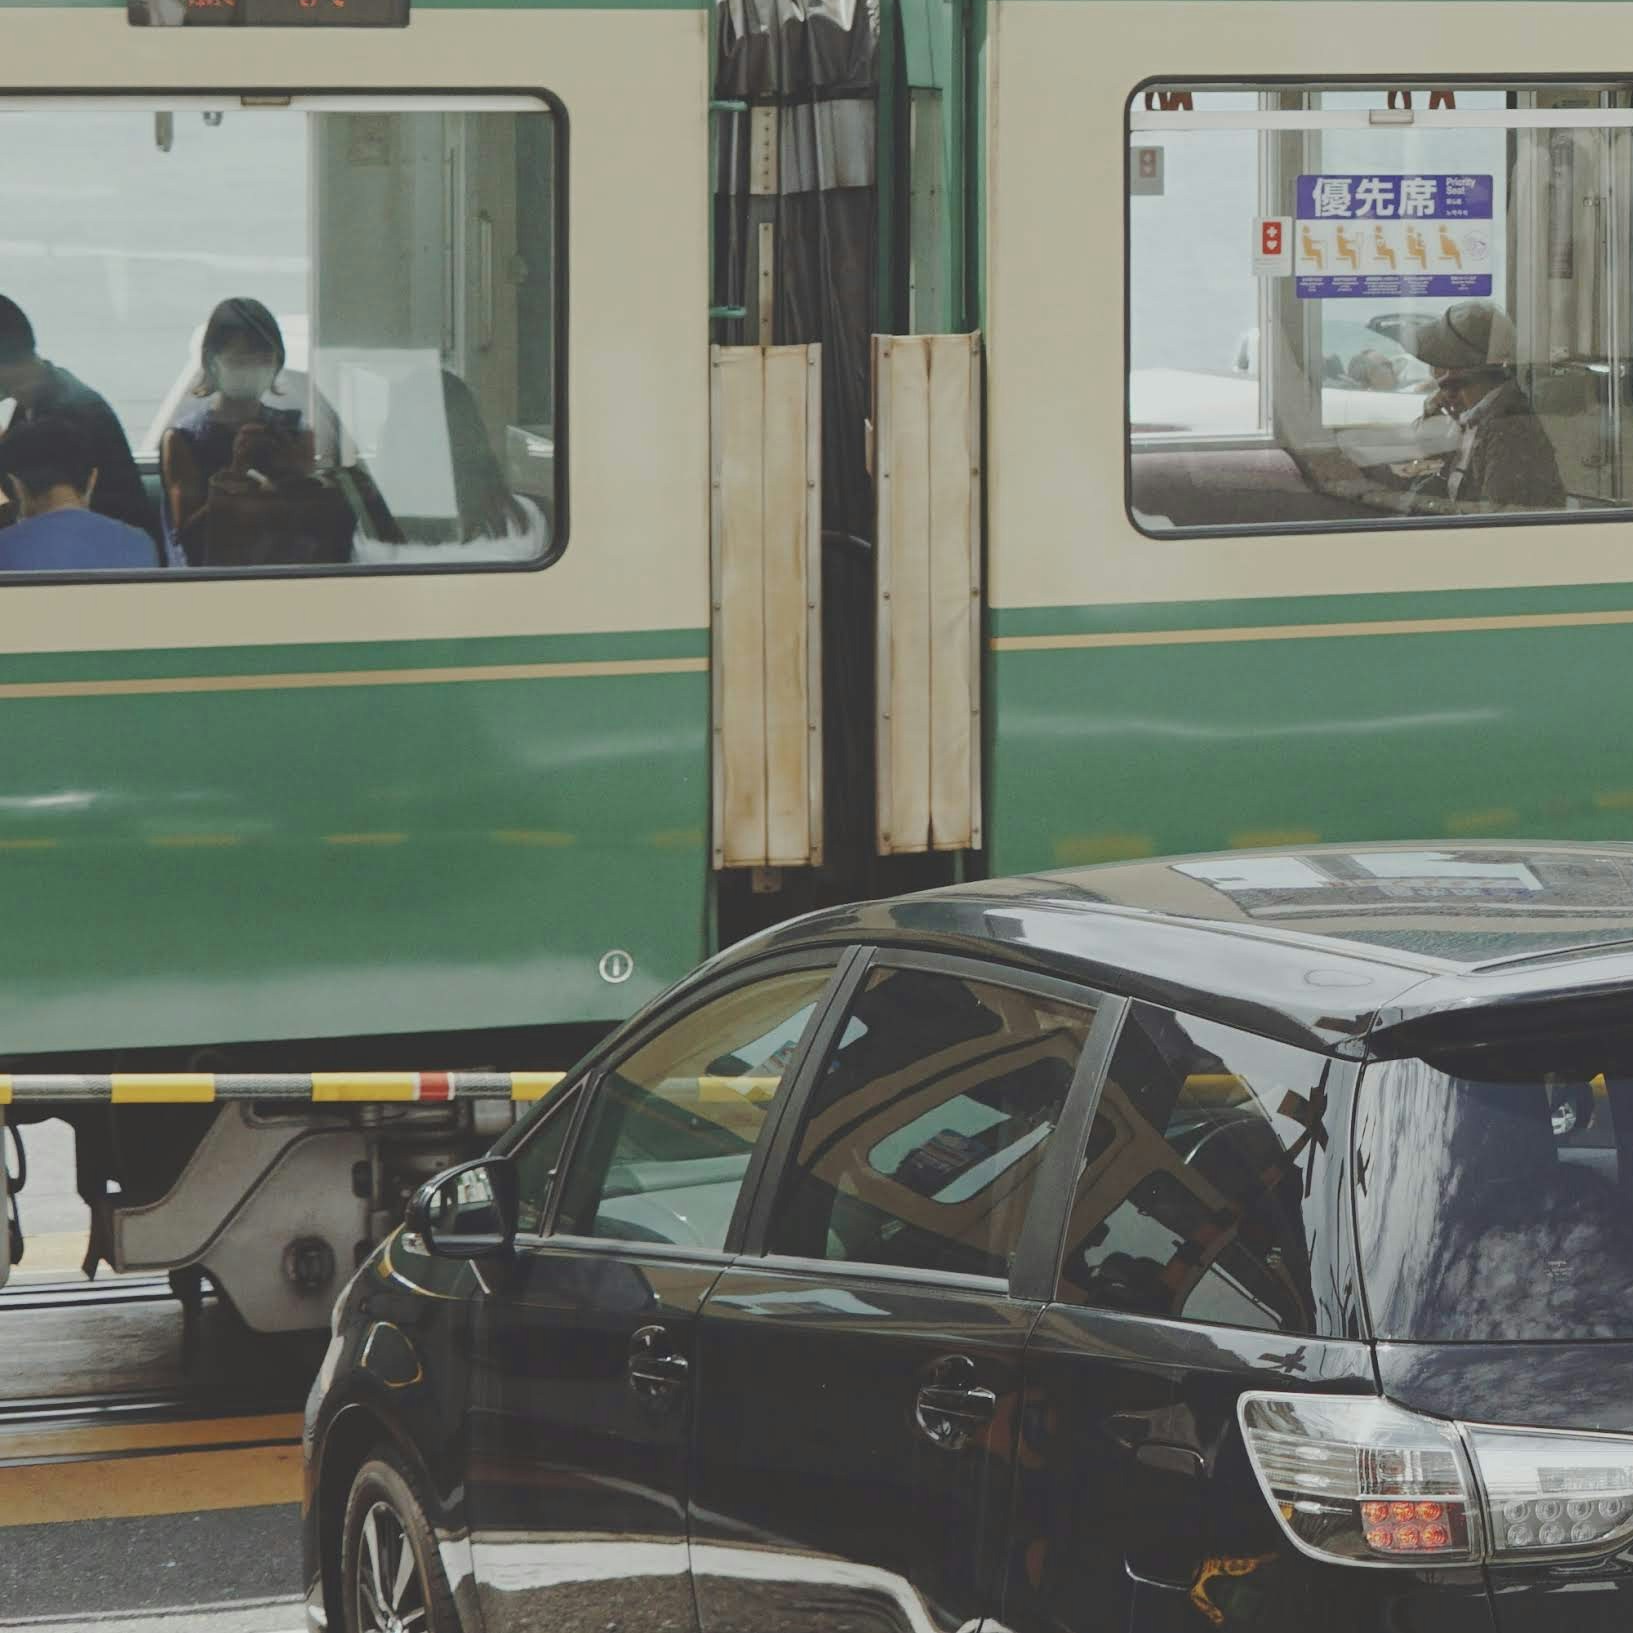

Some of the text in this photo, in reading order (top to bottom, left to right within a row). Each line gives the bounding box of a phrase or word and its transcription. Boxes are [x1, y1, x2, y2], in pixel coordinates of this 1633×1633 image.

[1446, 177, 1476, 190] Priority
[1312, 177, 1437, 217] 優先席
